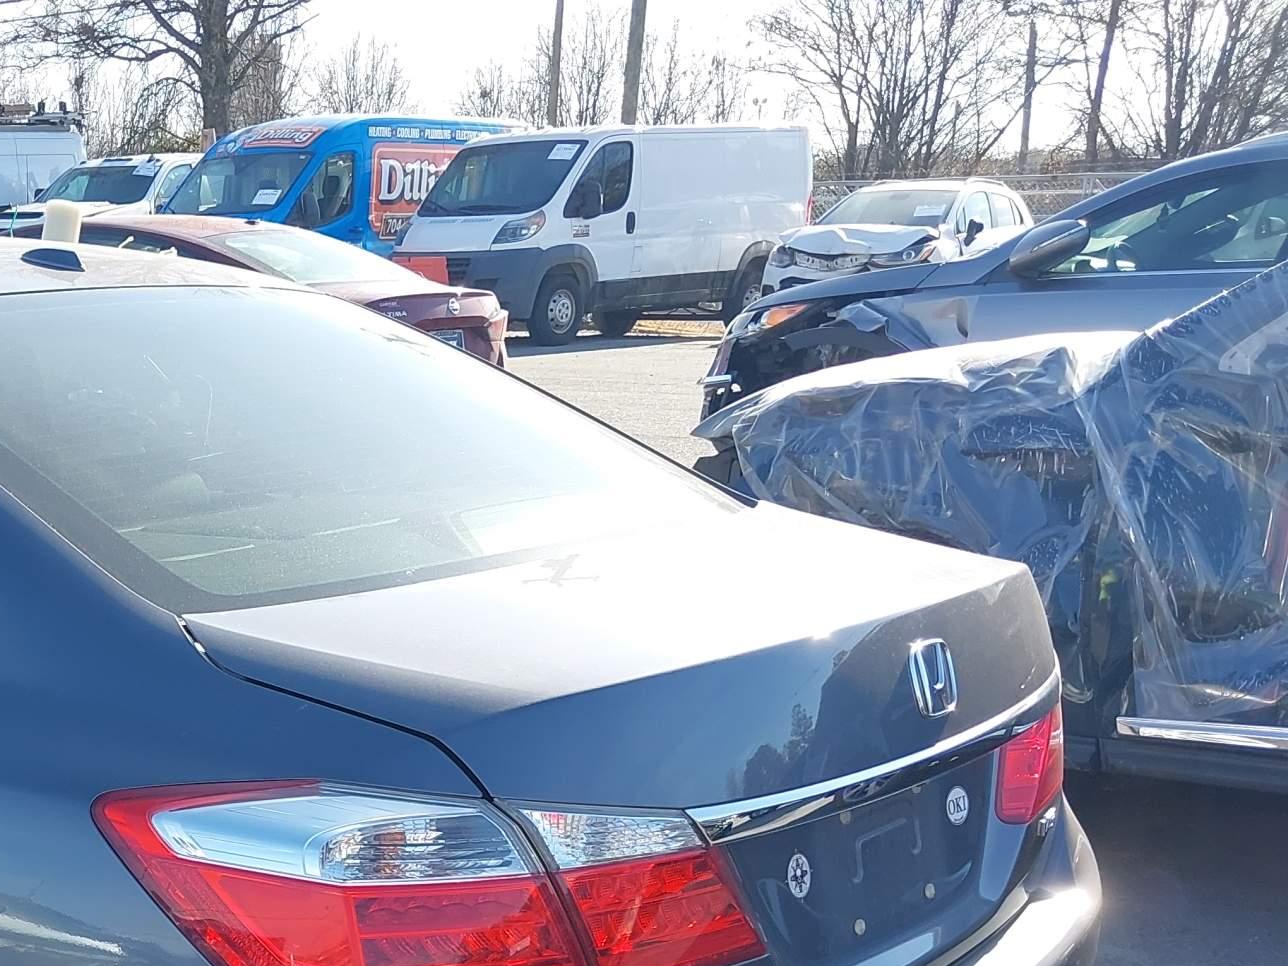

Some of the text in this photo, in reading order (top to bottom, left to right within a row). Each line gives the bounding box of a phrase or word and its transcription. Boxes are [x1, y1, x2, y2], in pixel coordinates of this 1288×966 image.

[368, 127, 392, 138] HEATING
[396, 127, 420, 139] COOLING
[948, 795, 967, 816] OKI
